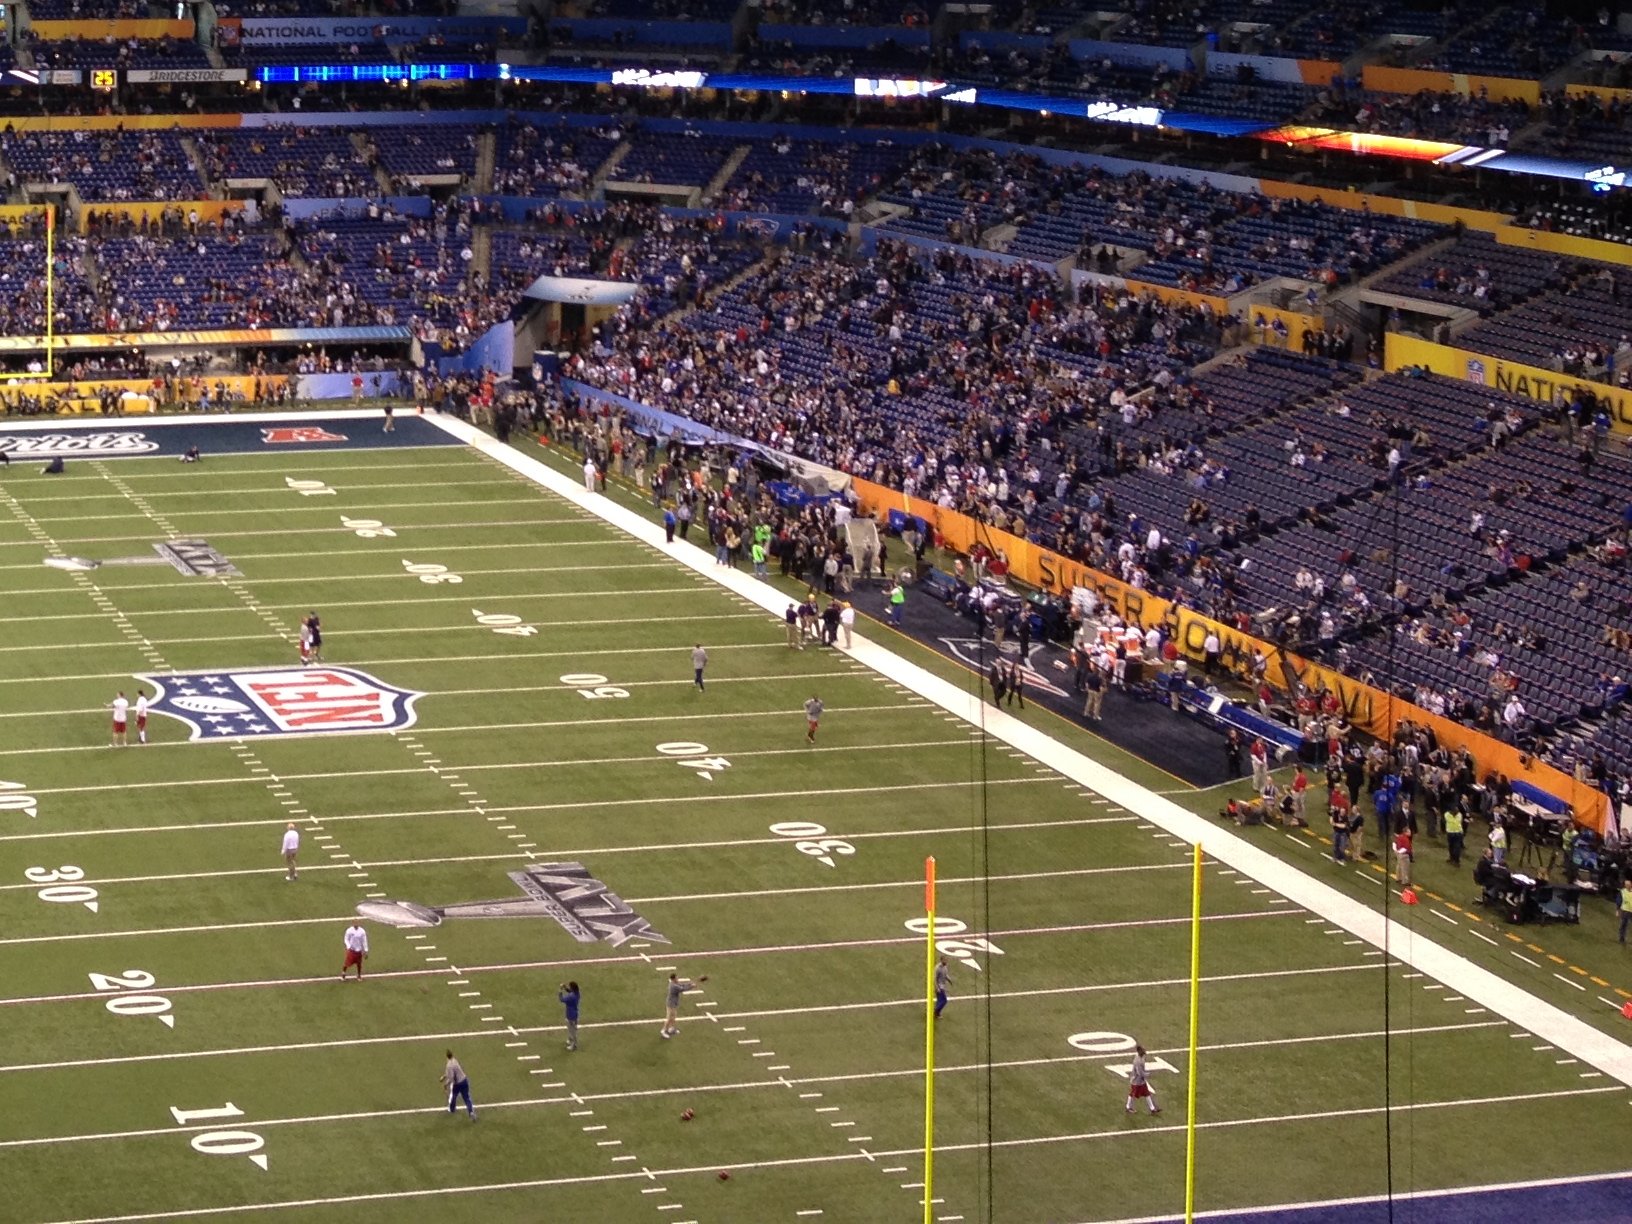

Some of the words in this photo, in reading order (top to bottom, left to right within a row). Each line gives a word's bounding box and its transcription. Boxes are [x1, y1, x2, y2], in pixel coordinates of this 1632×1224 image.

[242, 26, 325, 38] NATIONAL
[333, 26, 419, 37] FOOALL
[94, 70, 114, 86] 25
[149, 71, 224, 81] BRIDGESTONE
[1495, 366, 1632, 424] NATIAL
[248, 673, 386, 727] NFL
[559, 673, 631, 700] 50
[655, 741, 732, 771] 40
[769, 821, 857, 856] 30
[24, 865, 99, 903] 30
[904, 917, 1006, 955] 20
[88, 969, 173, 1015] 20
[169, 1102, 266, 1155] 10
